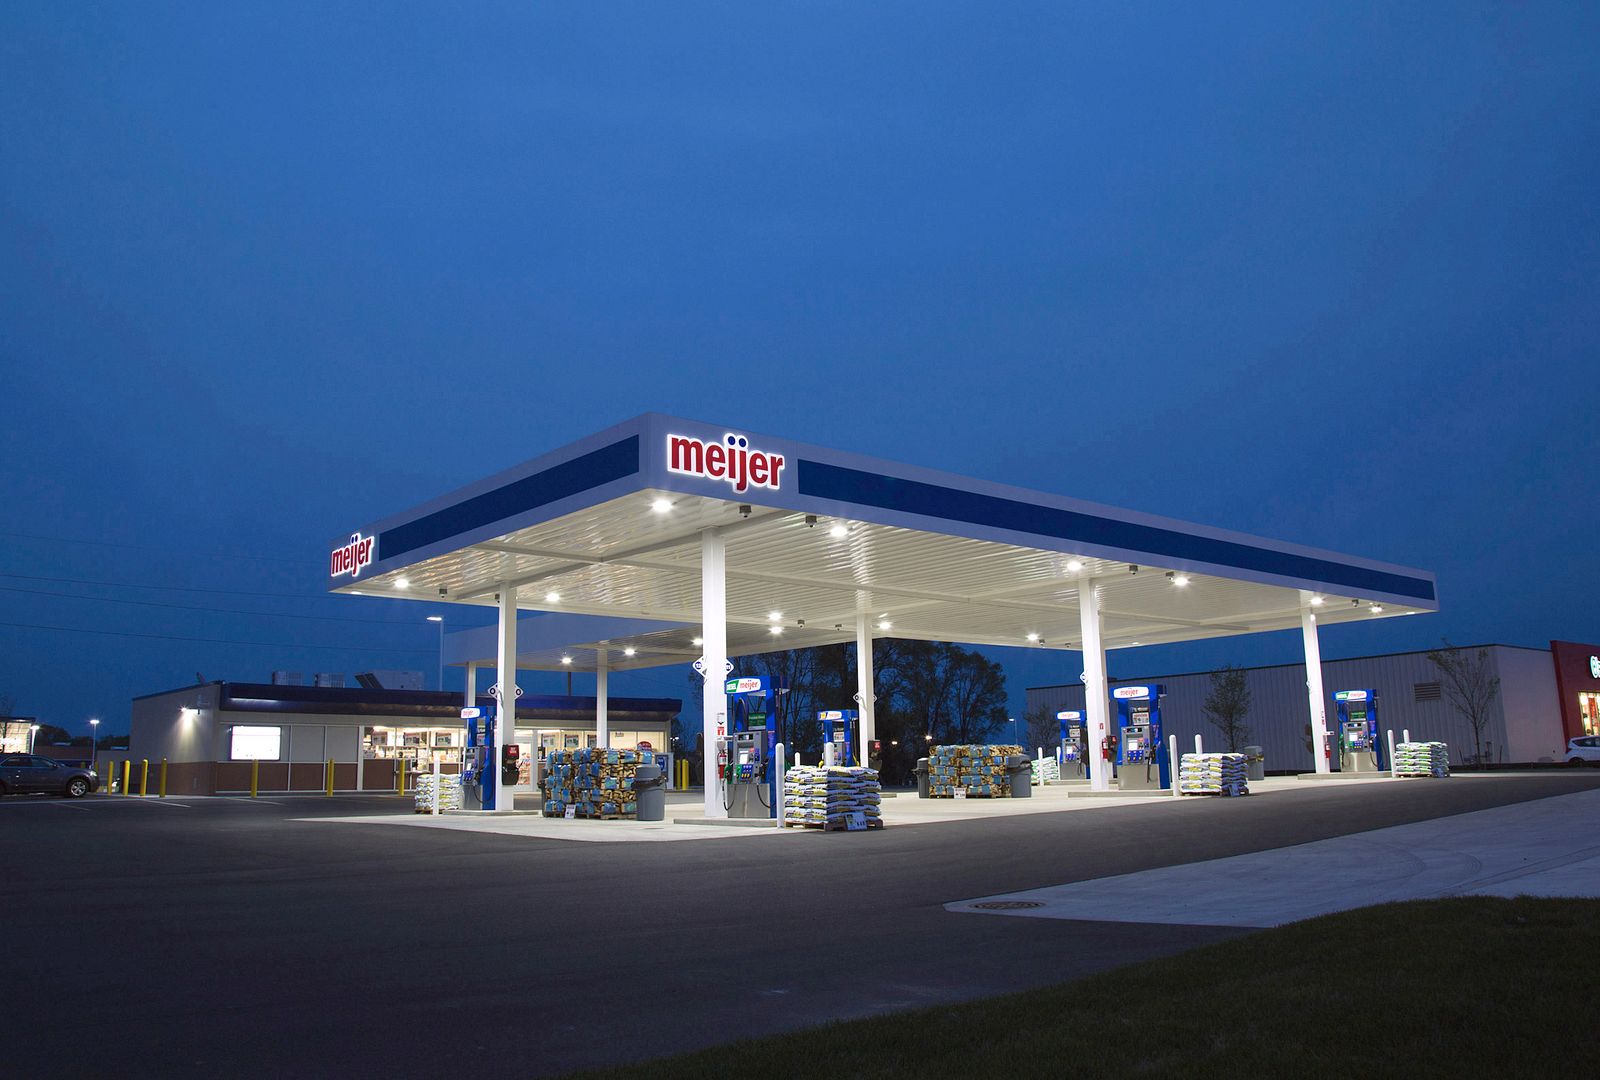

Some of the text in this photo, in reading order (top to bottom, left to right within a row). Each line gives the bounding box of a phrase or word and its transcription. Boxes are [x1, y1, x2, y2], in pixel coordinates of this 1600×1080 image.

[669, 434, 784, 493] meijer
[331, 533, 373, 576] meijer
[740, 679, 758, 690] meijer
[1120, 687, 1138, 696] meijer
